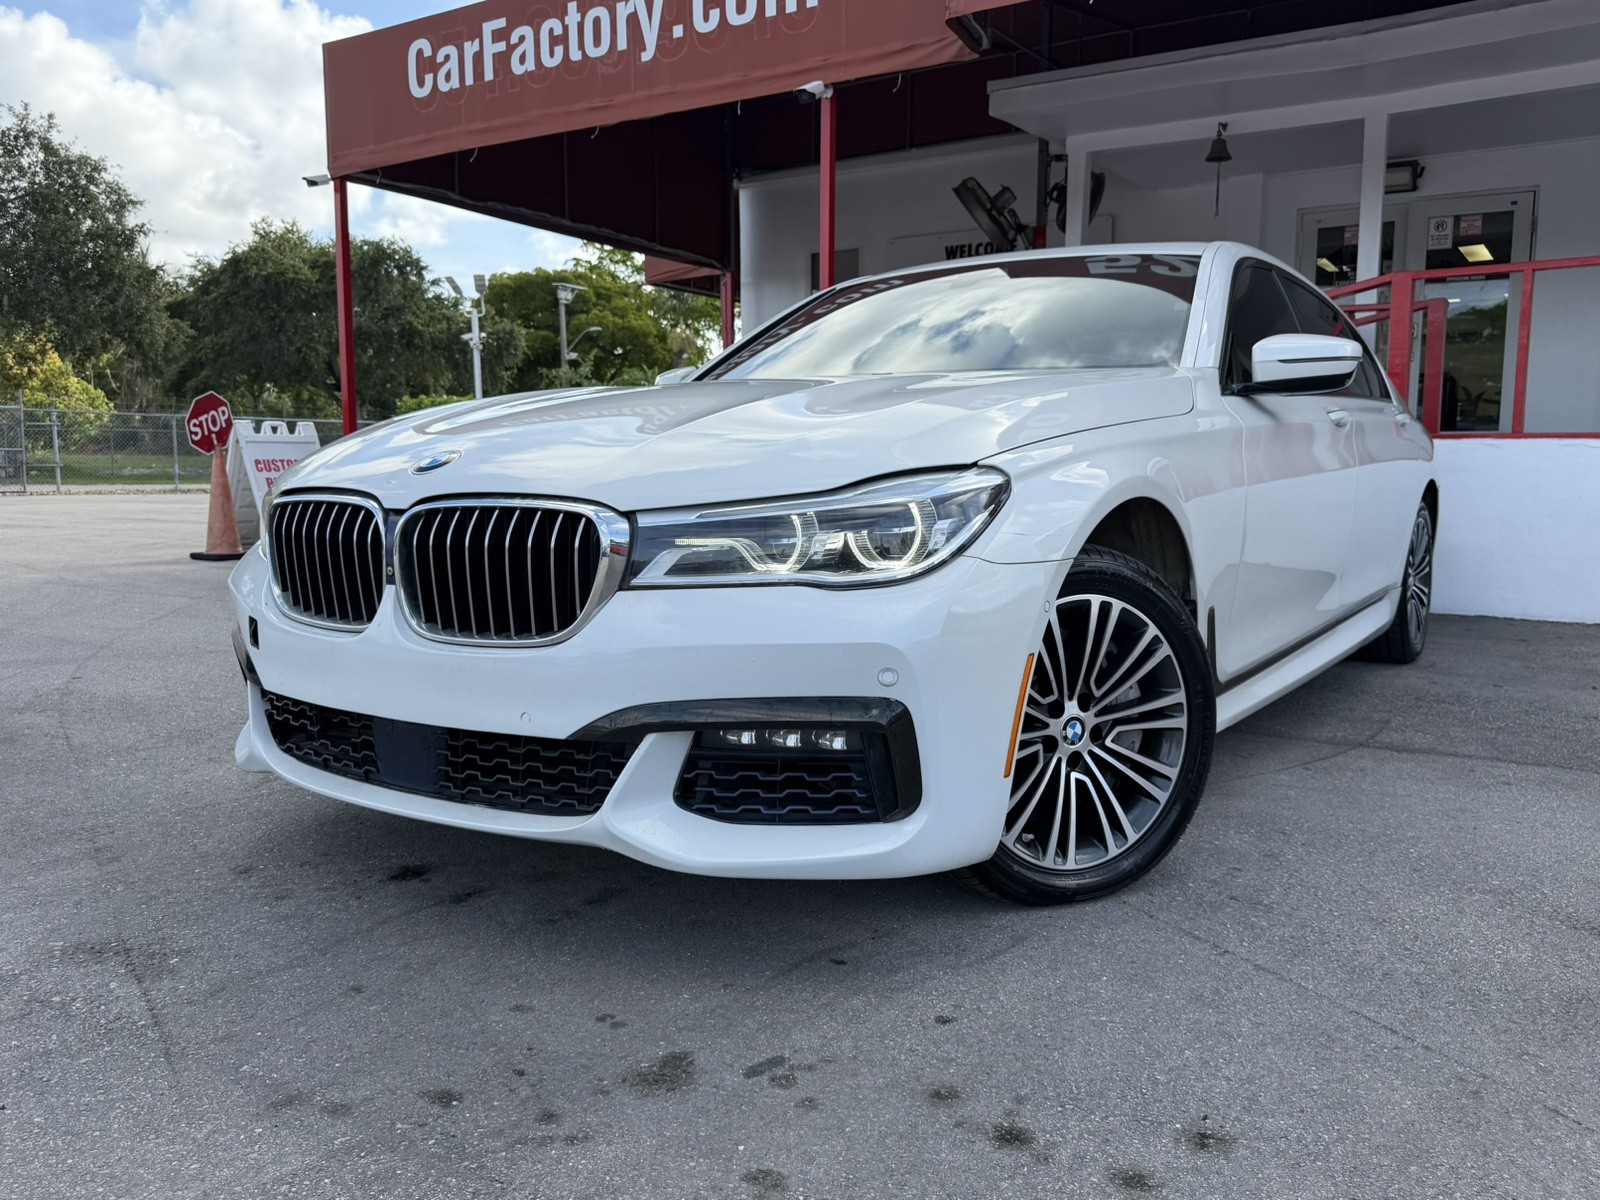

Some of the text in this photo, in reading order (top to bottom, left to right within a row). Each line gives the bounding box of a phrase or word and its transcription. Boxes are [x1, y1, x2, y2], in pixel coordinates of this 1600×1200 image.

[407, 0, 819, 99] CarFactory.c
[945, 240, 1017, 260] WELCOE
[189, 405, 229, 441] STOP
[254, 458, 298, 473] CUSTO
